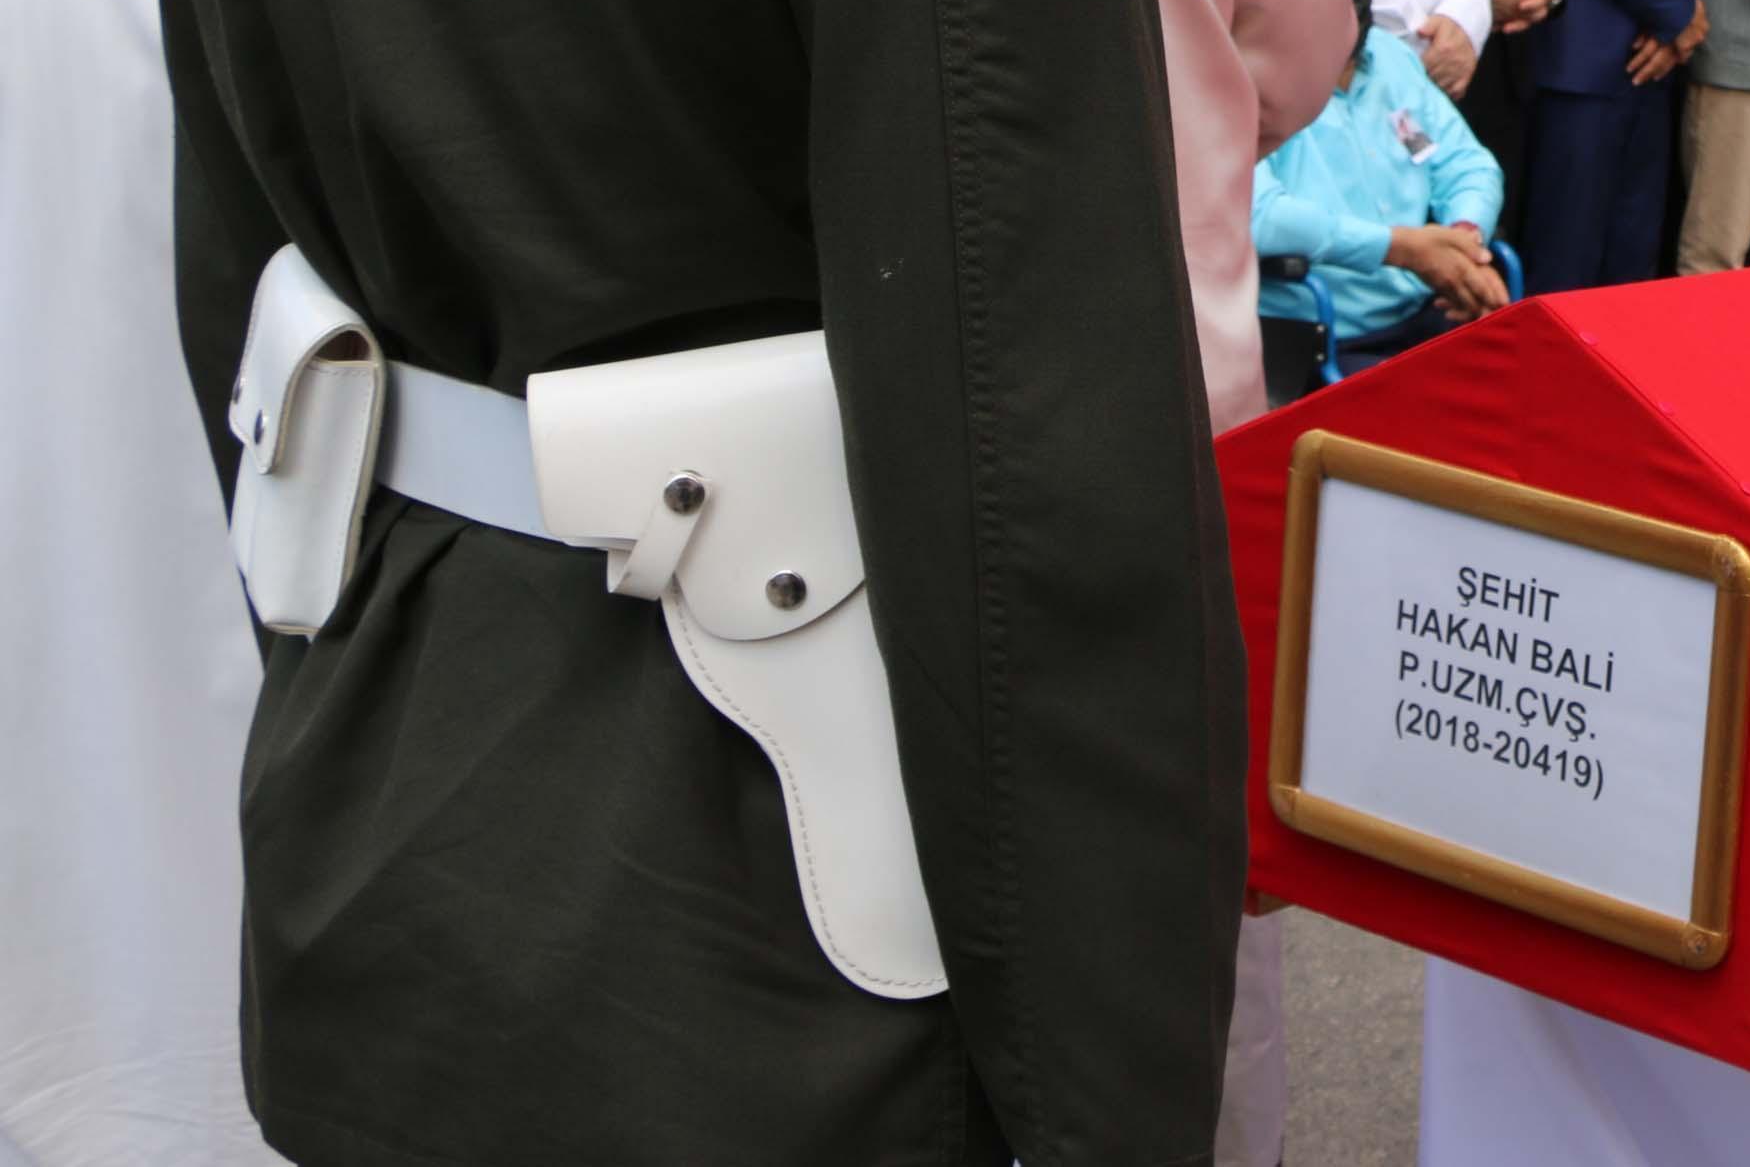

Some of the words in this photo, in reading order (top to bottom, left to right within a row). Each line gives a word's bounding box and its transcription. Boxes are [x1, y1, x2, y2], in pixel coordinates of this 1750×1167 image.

[1457, 566, 1560, 622] ŞEHİT
[1397, 599, 1518, 664] HAKAN
[1531, 638, 1614, 693] BALİ
[1395, 699, 1604, 801] (2018-20419)
